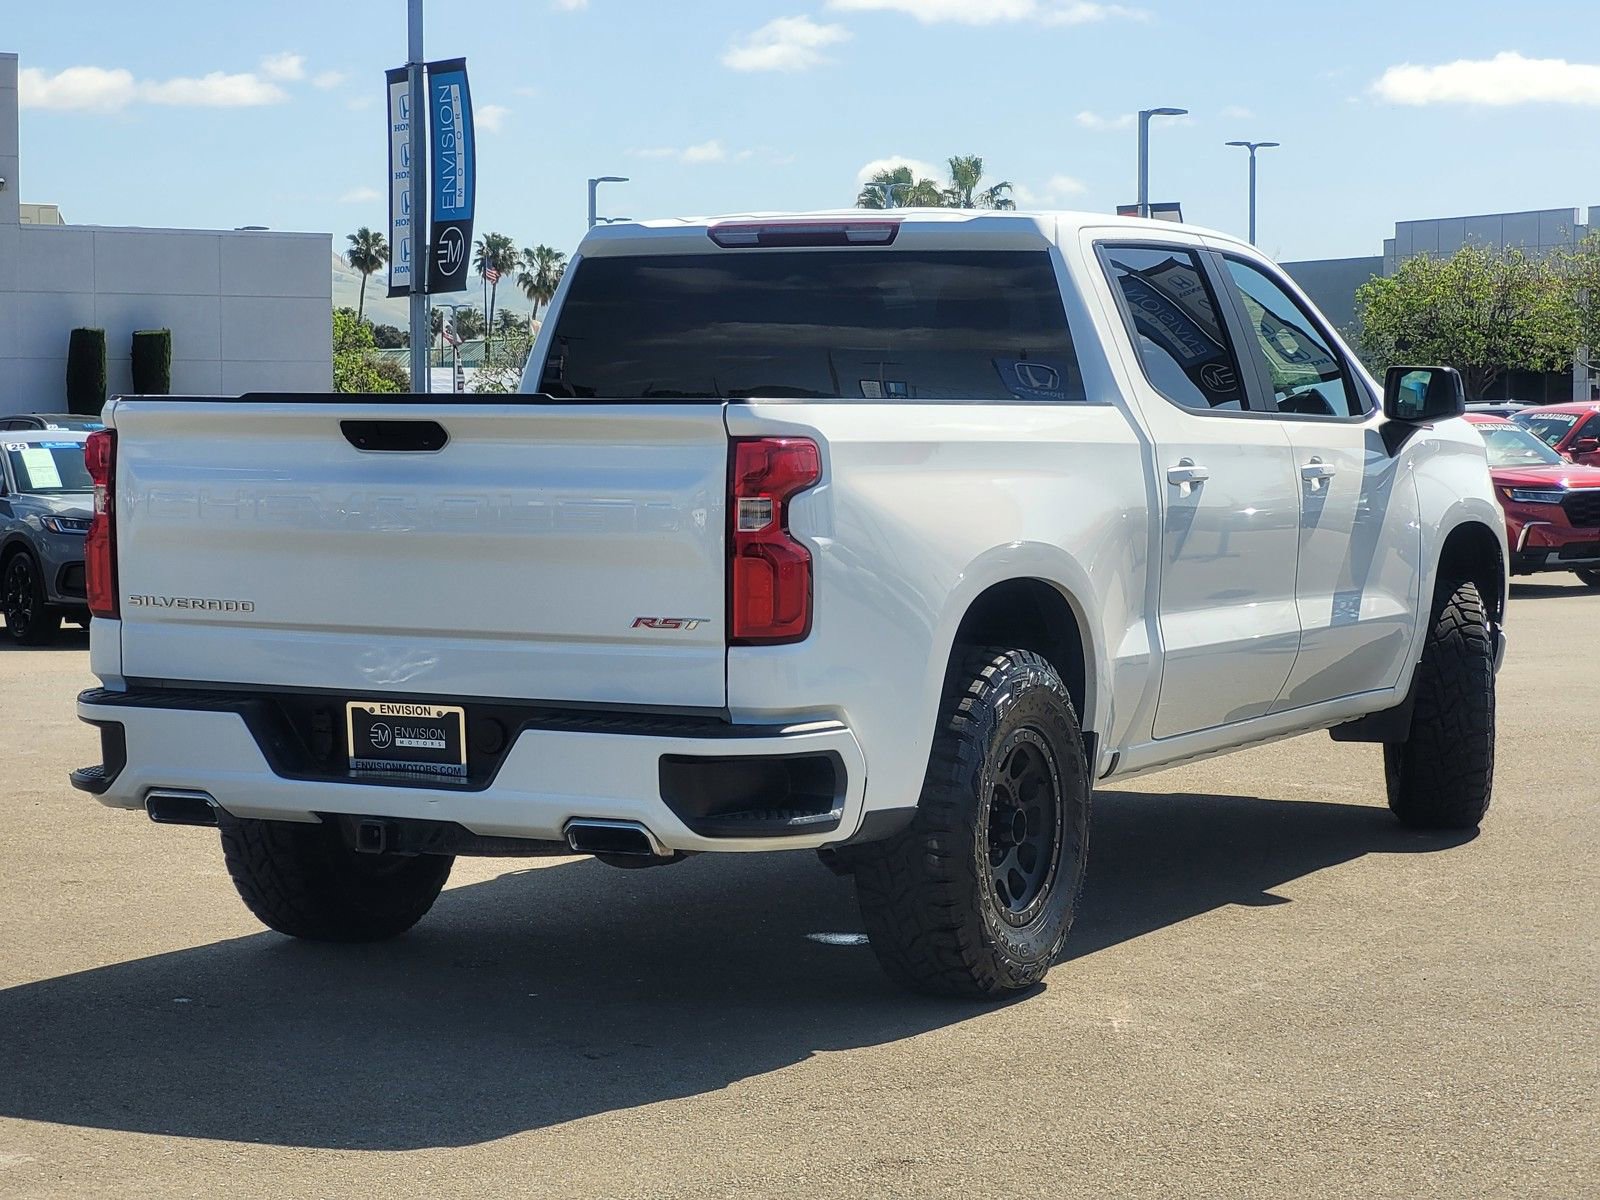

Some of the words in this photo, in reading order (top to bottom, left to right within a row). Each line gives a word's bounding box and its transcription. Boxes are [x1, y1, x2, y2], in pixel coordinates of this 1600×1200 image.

[438, 84, 456, 210] ENVISION
[454, 95, 464, 198] MOTORS
[394, 265, 410, 274] HON
[128, 594, 255, 613] SILVERADO
[630, 616, 711, 631] RST
[380, 704, 431, 716] ENVISION
[394, 726, 446, 740] ENVISION
[399, 739, 442, 747] MOTORS
[355, 761, 461, 776] ENVISIONMOTORS.COM
